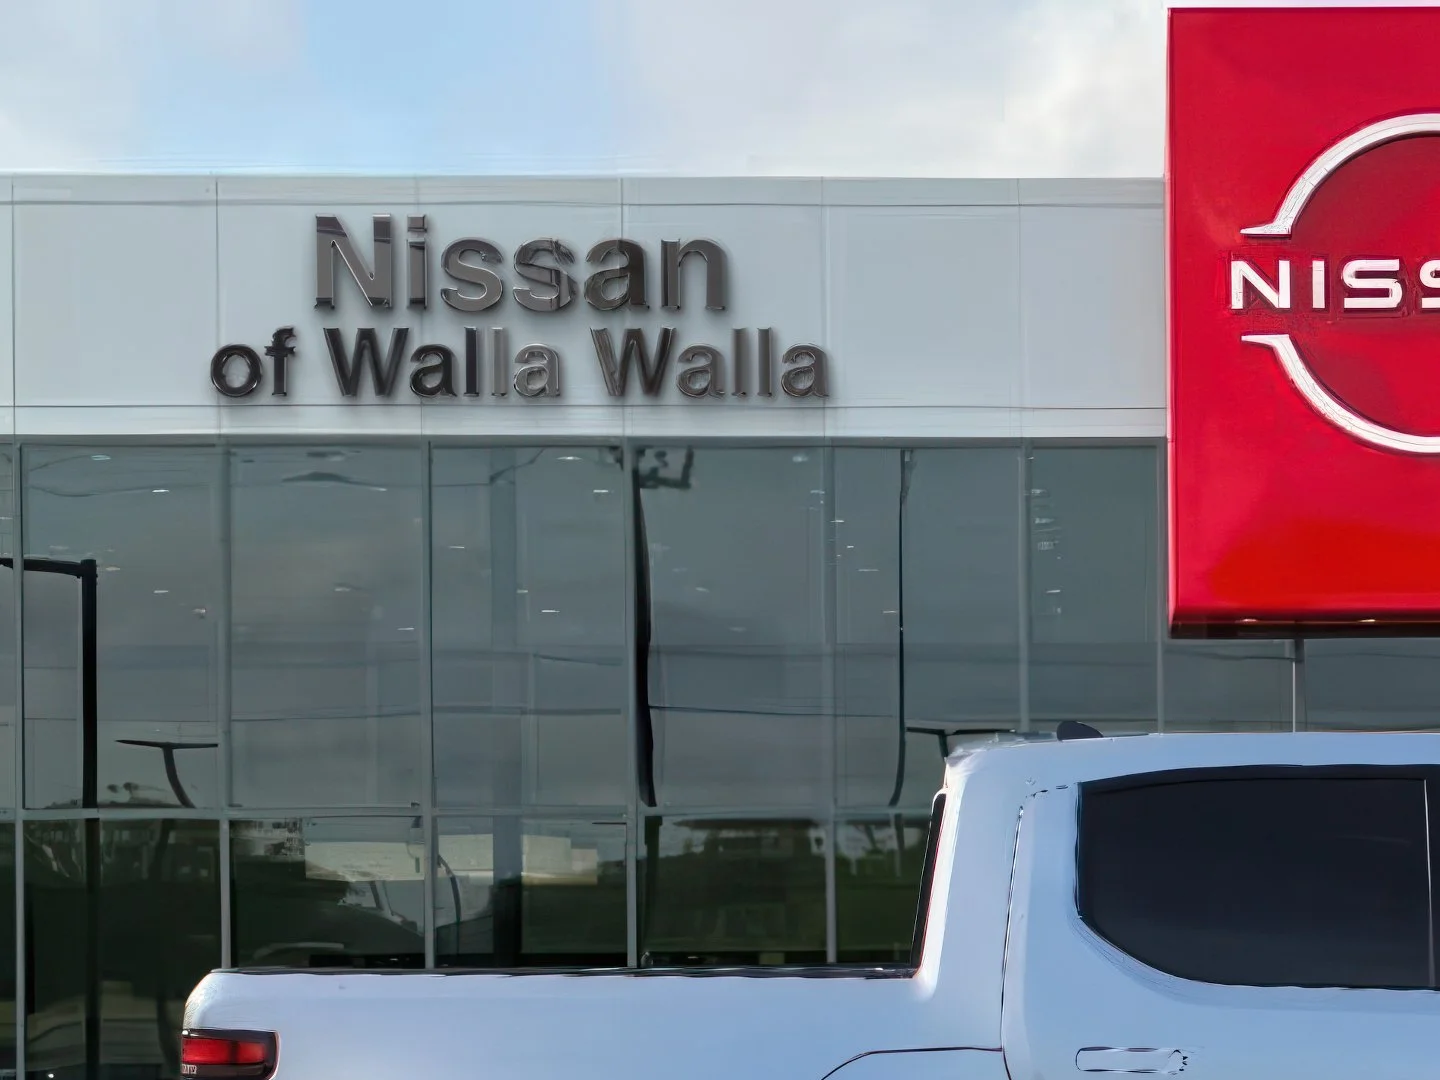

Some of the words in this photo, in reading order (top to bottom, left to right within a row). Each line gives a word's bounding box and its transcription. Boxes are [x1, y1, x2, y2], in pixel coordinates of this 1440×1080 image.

[314, 212, 730, 312] Nissan
[209, 326, 296, 397] of
[322, 326, 561, 398] Walla
[590, 326, 830, 398] Walla
